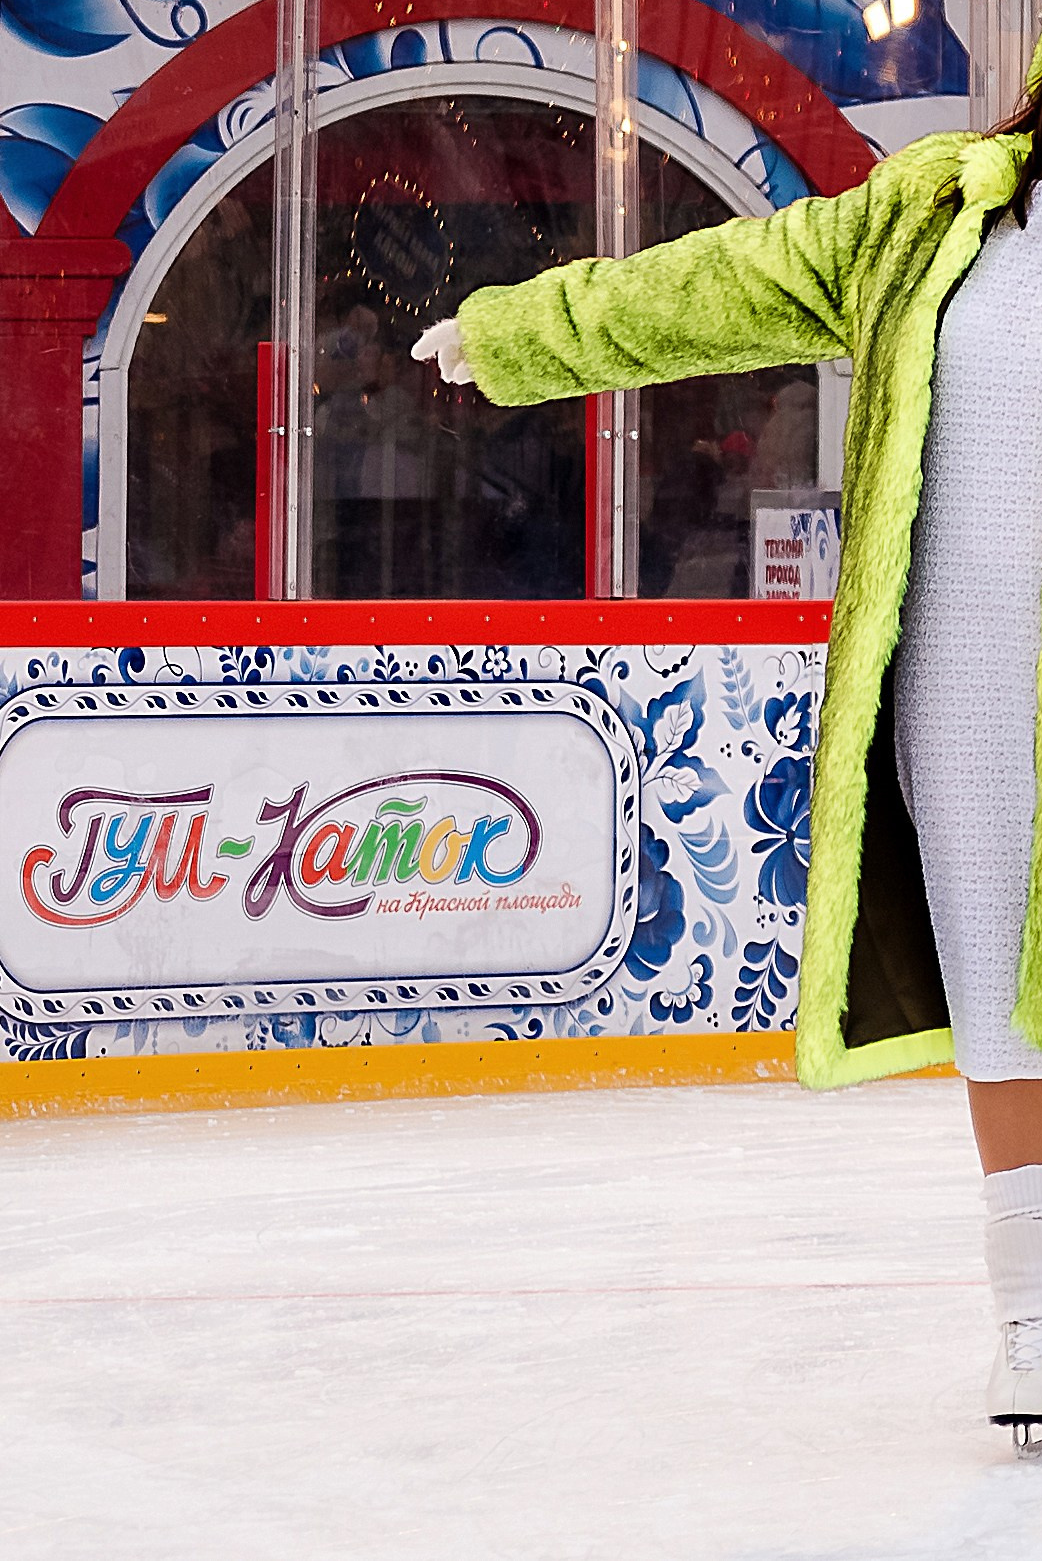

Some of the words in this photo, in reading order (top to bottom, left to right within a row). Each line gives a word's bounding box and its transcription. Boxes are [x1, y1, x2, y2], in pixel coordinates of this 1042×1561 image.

[766, 565, 801, 587] ПРОХОД
[376, 899, 401, 914] на
[404, 890, 490, 920] Красной
[495, 883, 583, 914] площади
